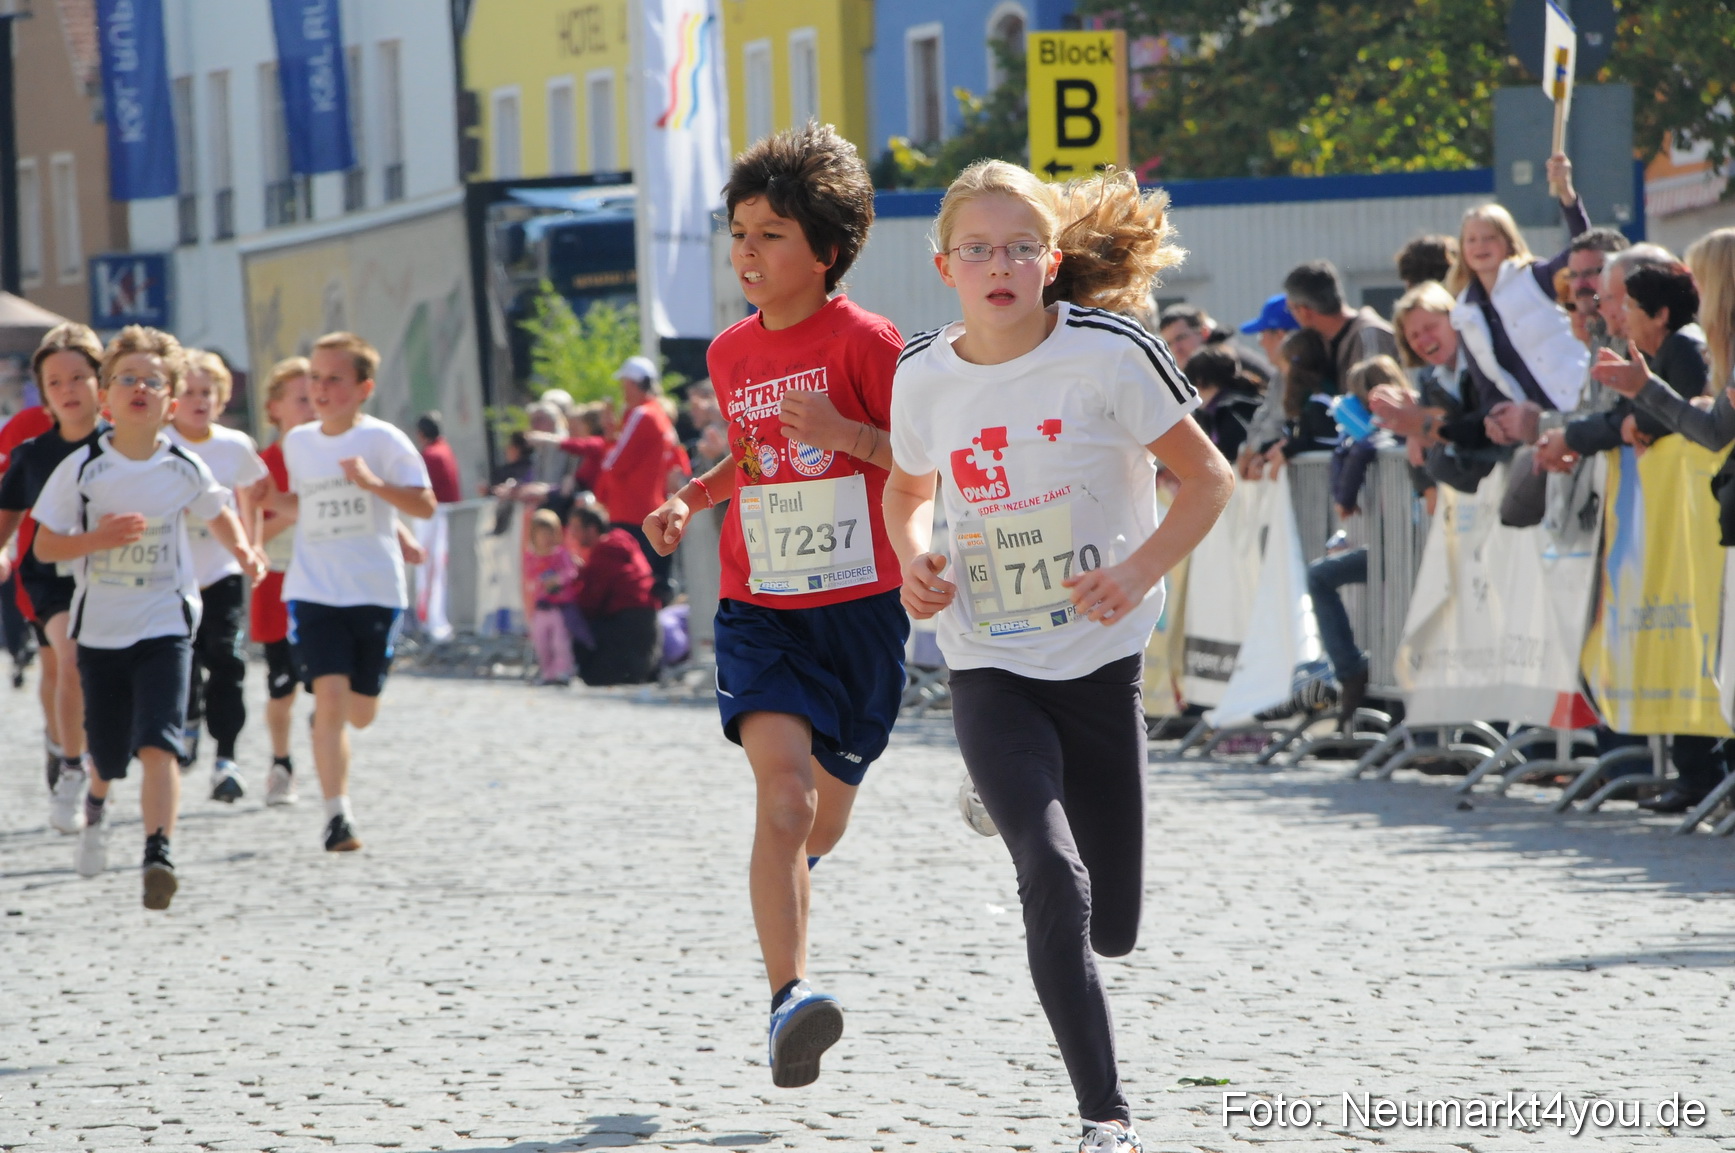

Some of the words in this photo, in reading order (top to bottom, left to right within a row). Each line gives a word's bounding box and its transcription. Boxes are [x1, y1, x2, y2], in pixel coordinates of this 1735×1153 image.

[1039, 38, 1113, 65] Block
[1055, 78, 1101, 148] B
[962, 481, 1007, 500] DKMS
[1043, 485, 1072, 502] ZÄHLT
[317, 498, 366, 520] 7316
[769, 491, 803, 514] Paul
[748, 528, 757, 543] K
[774, 519, 858, 557] 7237
[996, 527, 1043, 550] Anna
[118, 544, 169, 564] 7051
[822, 565, 874, 582] PFLEIDERER
[969, 564, 988, 582] K5
[1004, 544, 1101, 595] 7170
[989, 619, 1031, 633] BOCK
